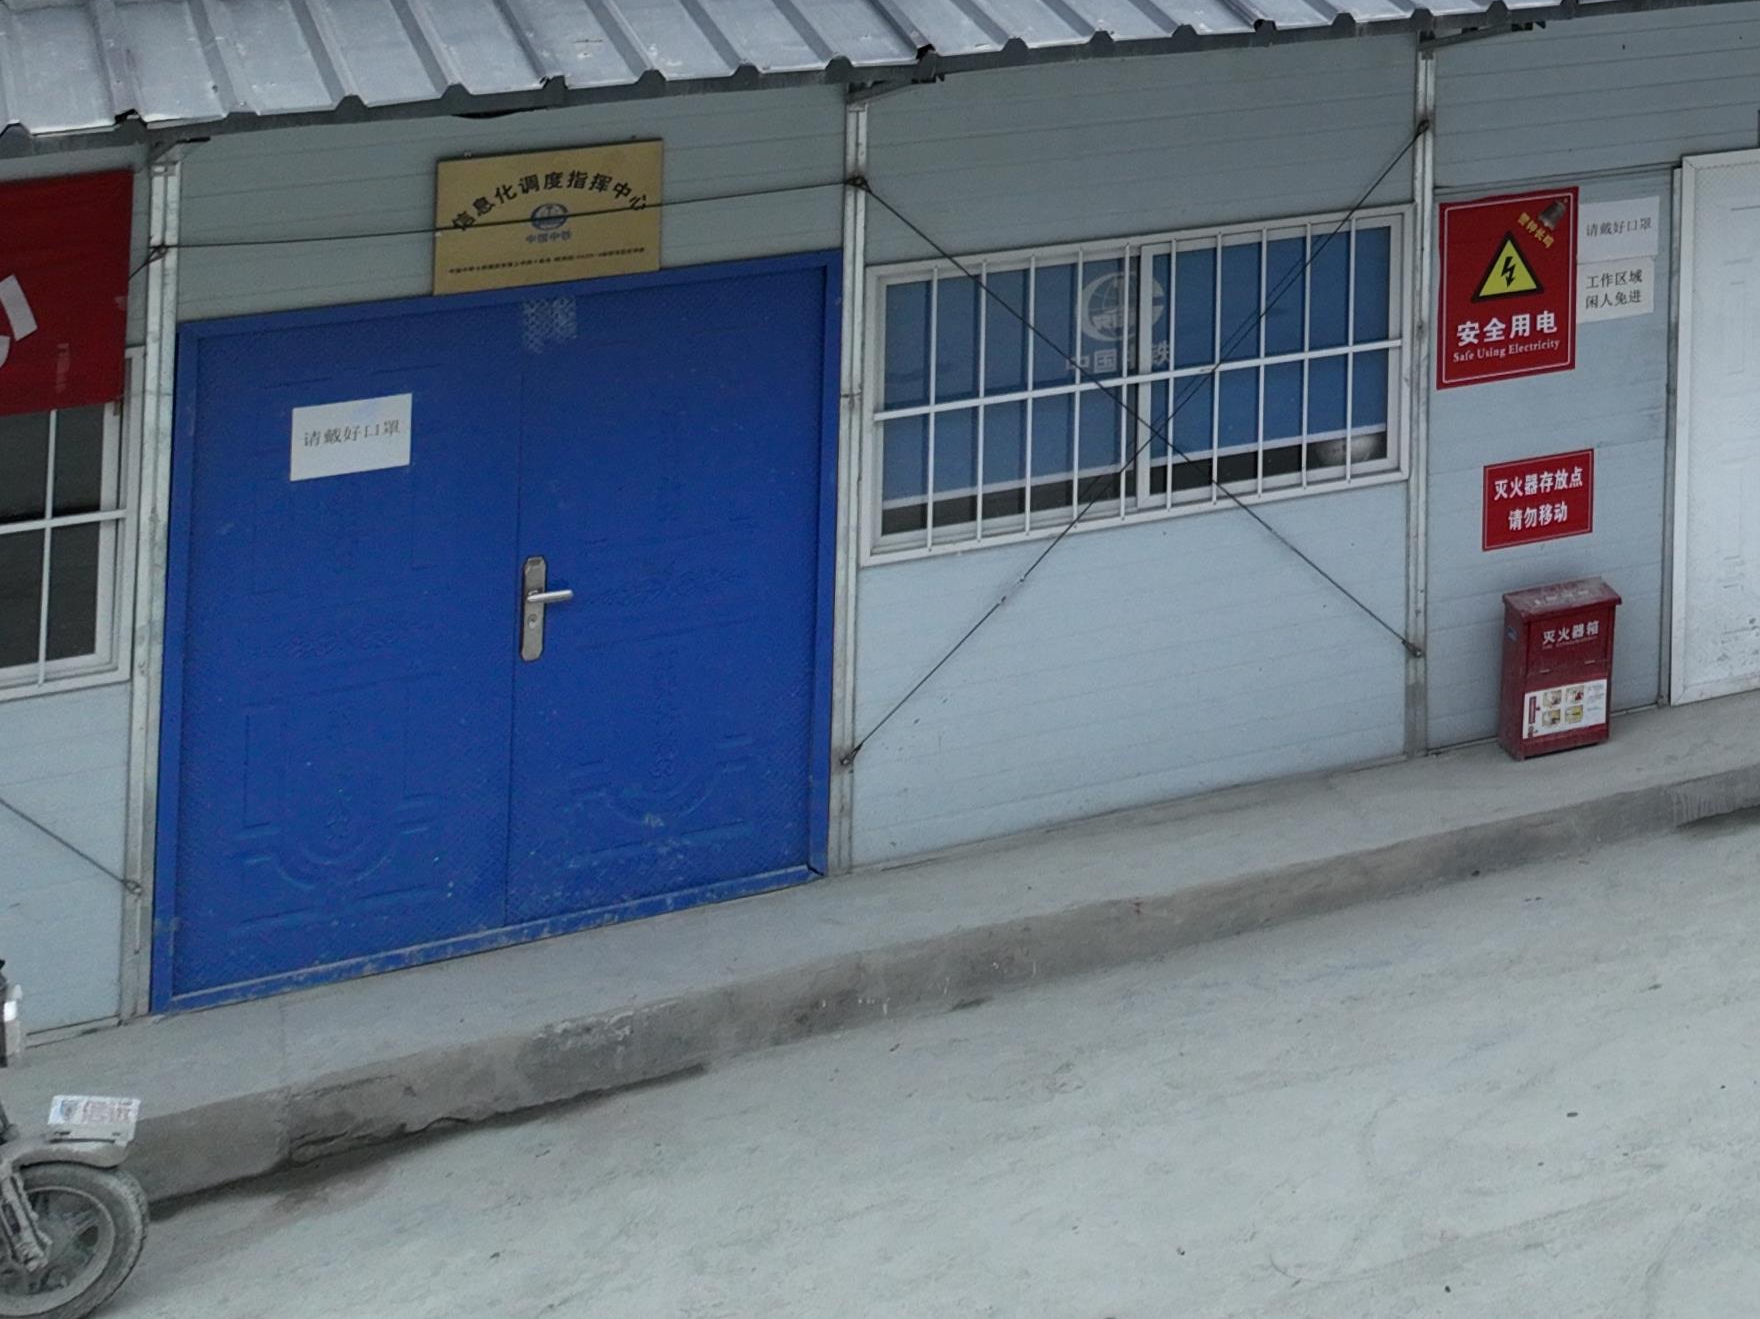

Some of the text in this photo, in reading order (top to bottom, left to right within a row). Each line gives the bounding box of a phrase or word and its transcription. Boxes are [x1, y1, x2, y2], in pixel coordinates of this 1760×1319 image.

[452, 170, 648, 231] 信息化调度指挥中心
[1586, 217, 1653, 237] 请戴好口罩
[1586, 269, 1643, 289] 工作区域
[1585, 290, 1642, 309] 闲人免进
[1457, 310, 1558, 346] 安全用电
[1452, 339, 1561, 363] Safe Using Electricity
[304, 418, 400, 447] 请戴好口罩
[1494, 467, 1583, 500] 灭火器存放点
[1508, 501, 1568, 532] 请勿移动
[1542, 621, 1600, 644] 灭火器箱
